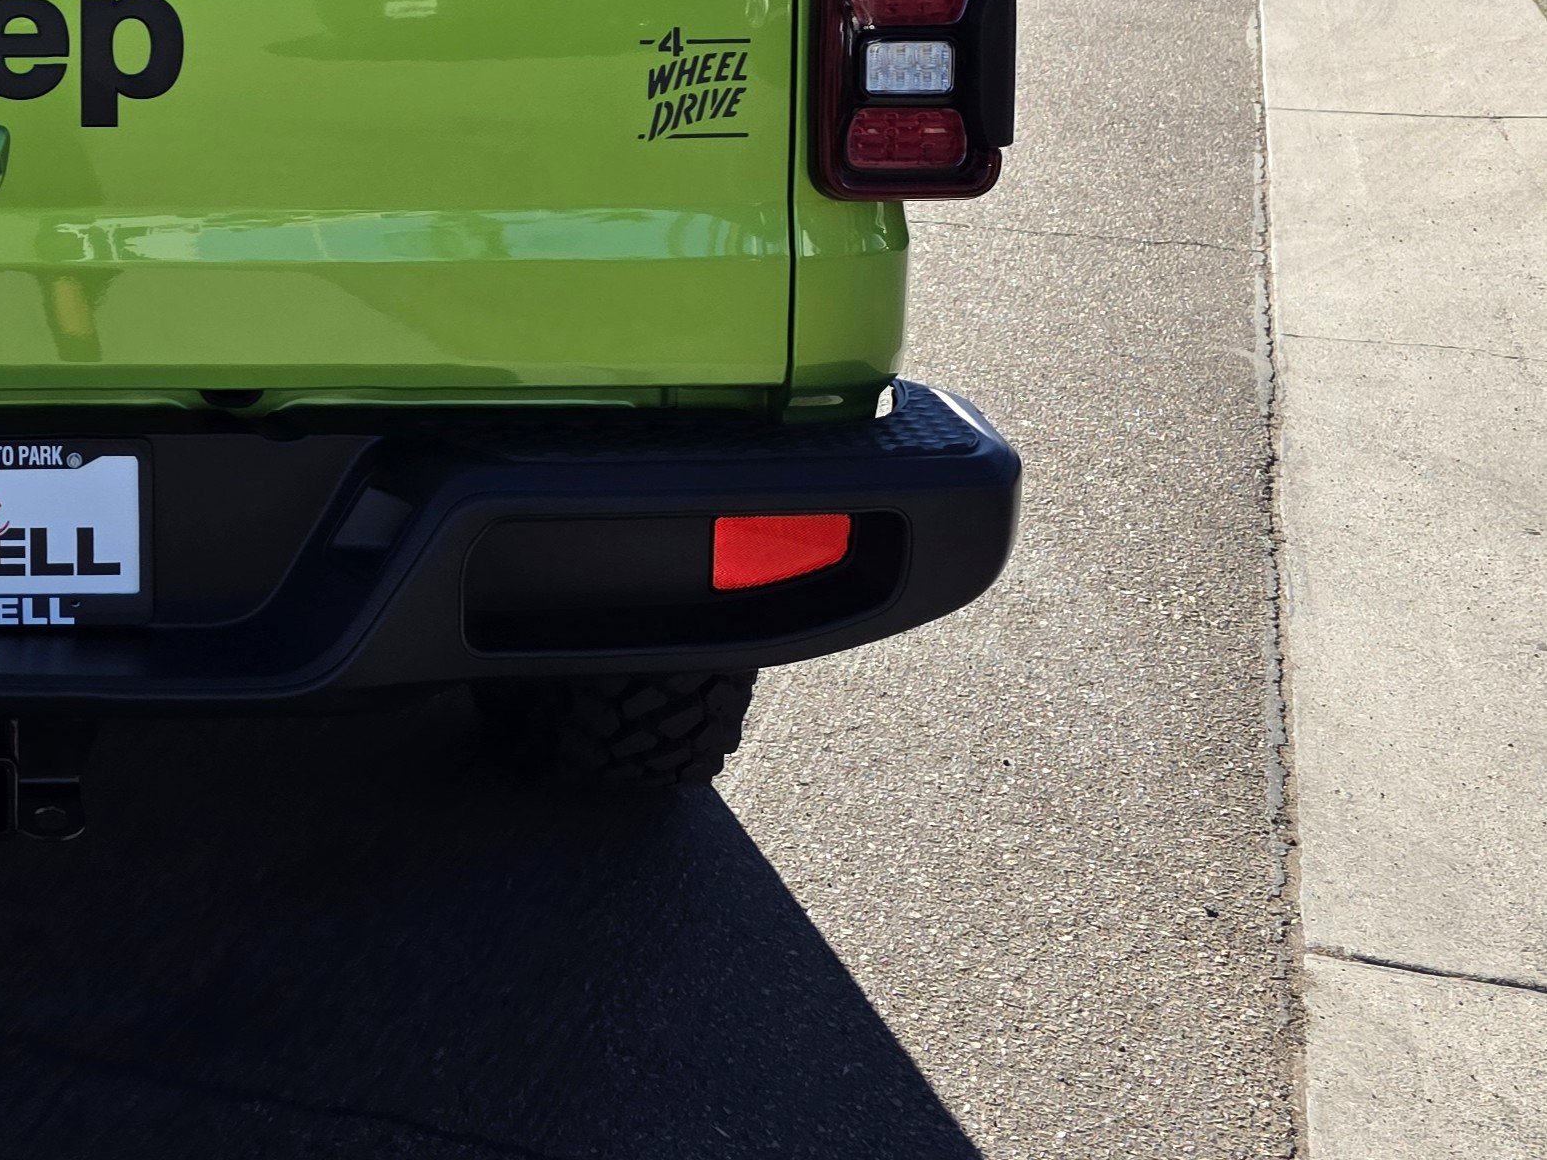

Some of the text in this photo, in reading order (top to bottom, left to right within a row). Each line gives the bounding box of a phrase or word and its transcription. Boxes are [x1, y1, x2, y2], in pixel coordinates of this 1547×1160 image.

[658, 27, 684, 57] 4
[648, 52, 748, 100] WHEEL
[647, 87, 747, 142] DRIVE
[18, 445, 63, 466] PARK
